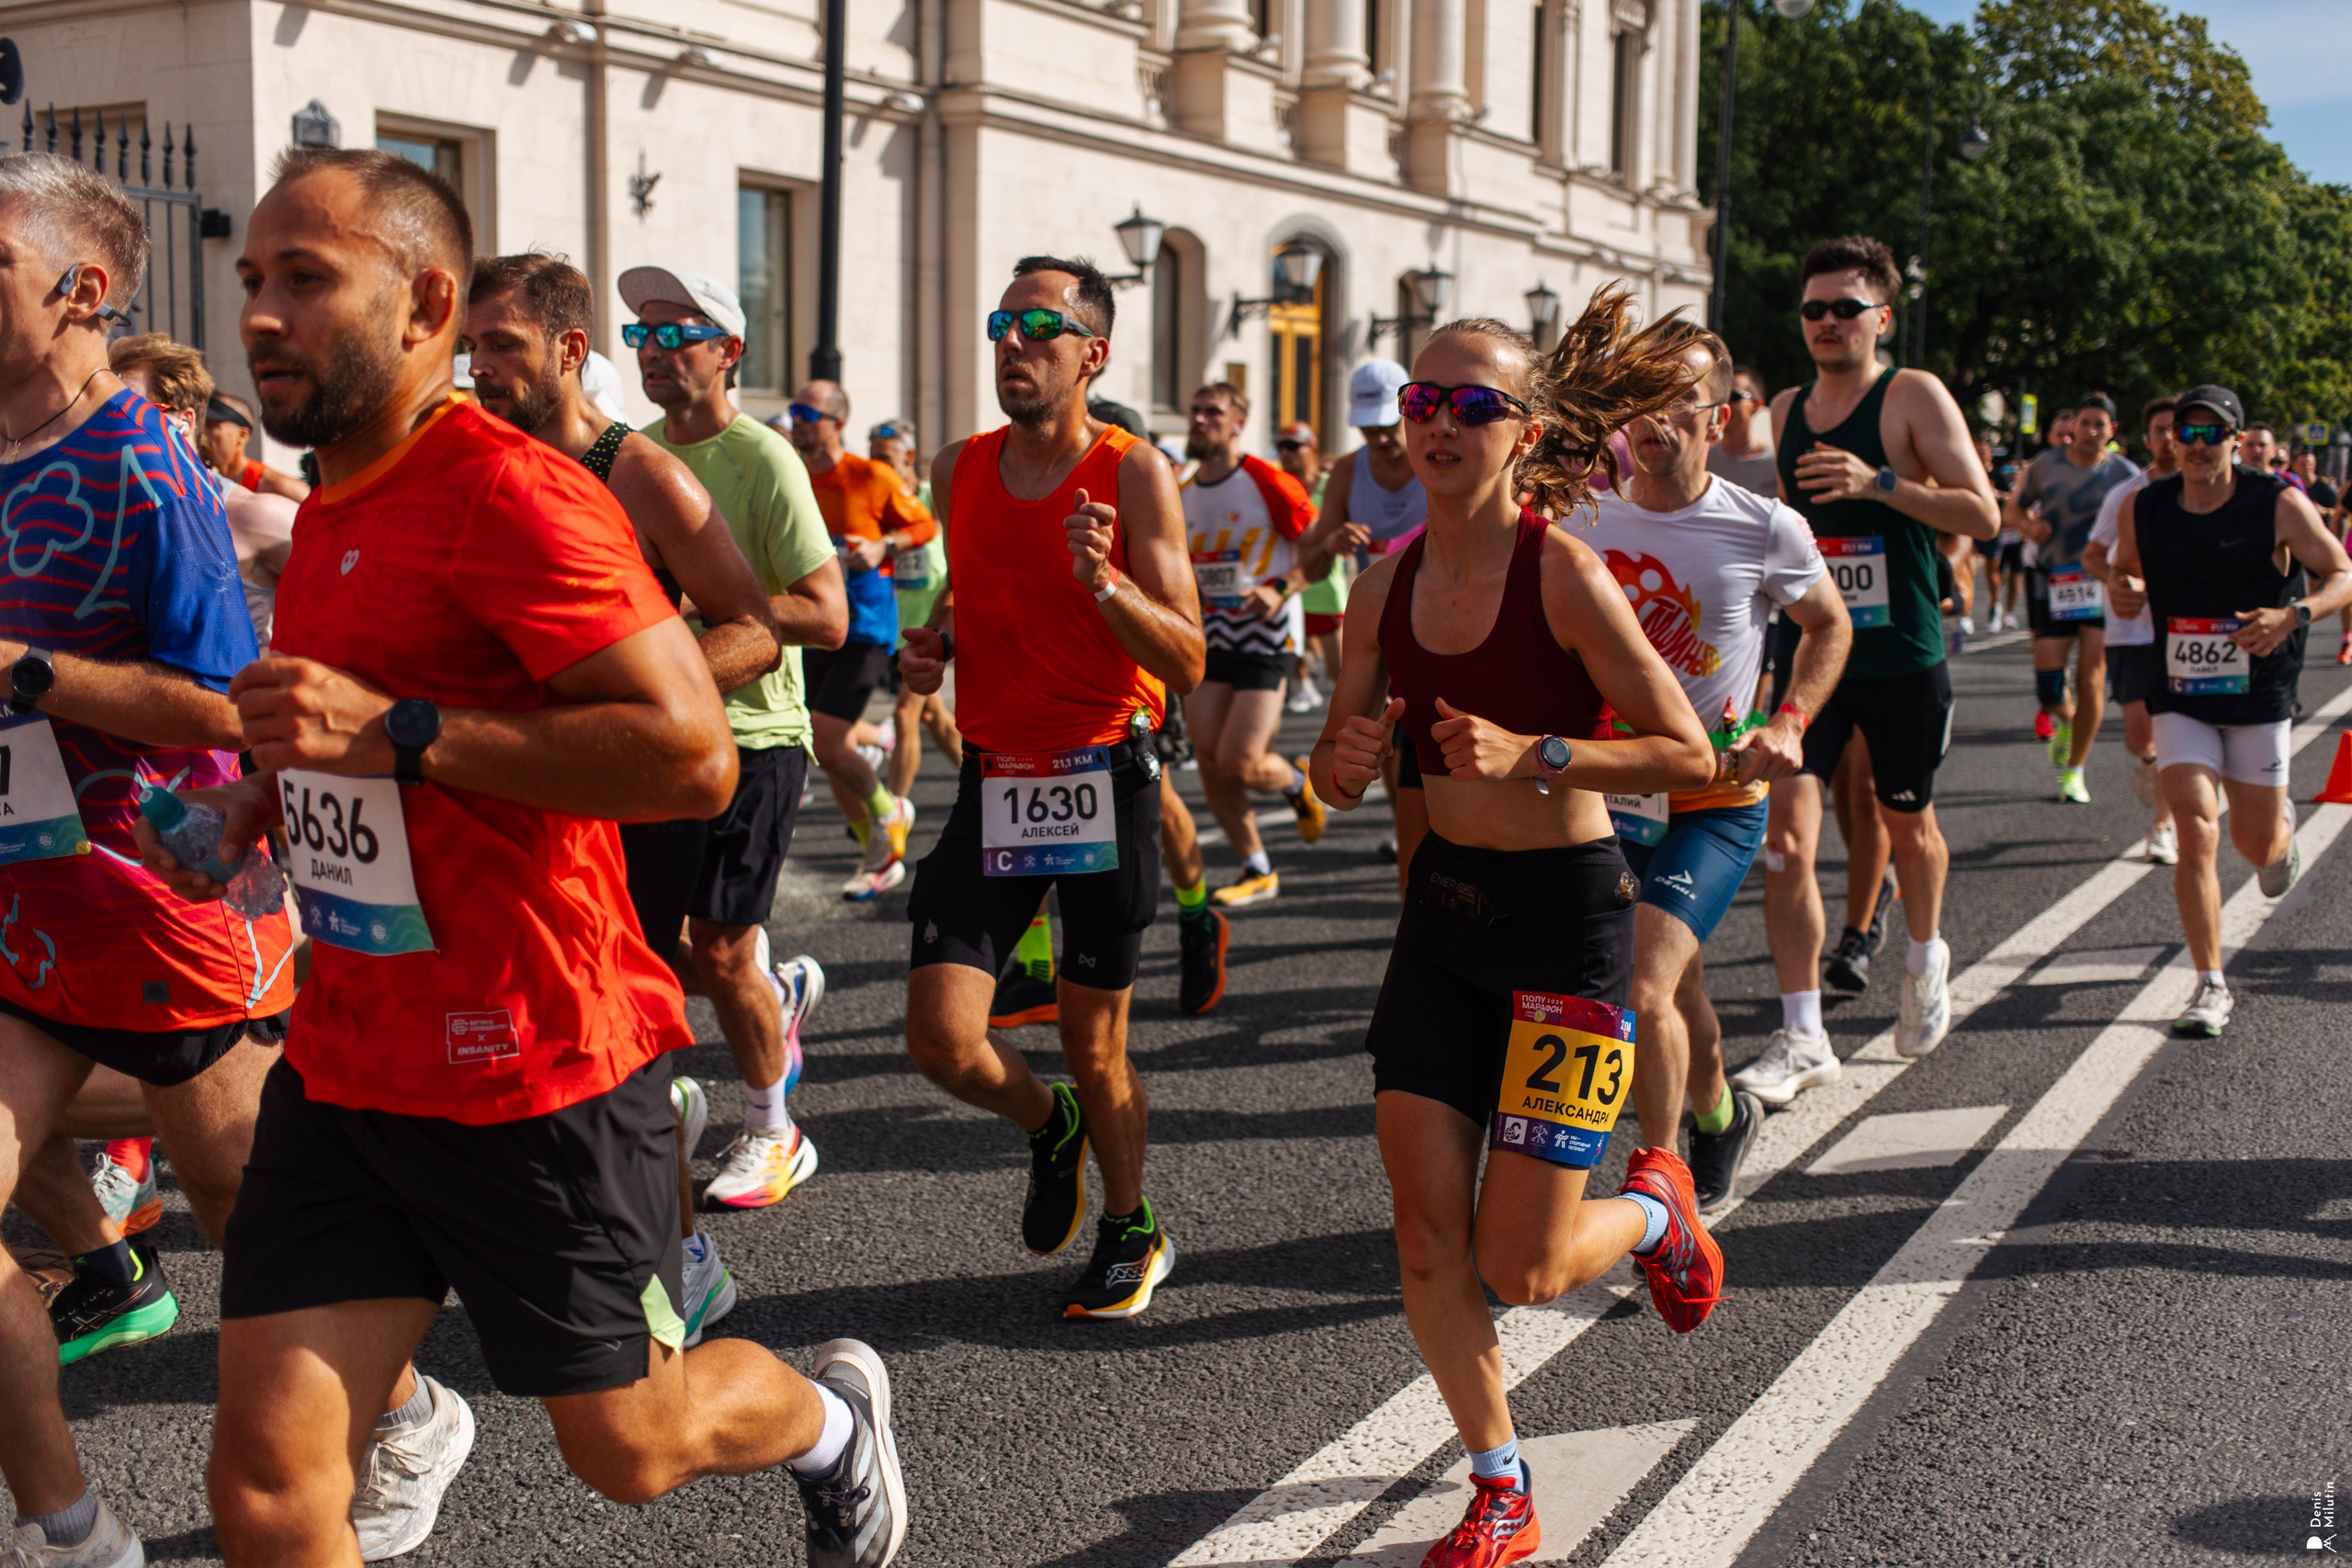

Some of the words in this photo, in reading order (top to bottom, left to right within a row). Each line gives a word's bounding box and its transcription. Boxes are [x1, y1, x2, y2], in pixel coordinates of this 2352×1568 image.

[1826, 564, 1873, 591] 00
[2175, 640, 2237, 664] 4862
[1052, 758, 1072, 769] 21,1
[1074, 754, 1093, 766] КМ
[1003, 783, 1098, 824] 1630
[283, 779, 379, 863] 5636
[1021, 822, 1080, 839] АЛЕКСЕЙ
[311, 858, 353, 886] ДАНИЛ
[997, 851, 1012, 872] C
[1521, 994, 1546, 1004] ПОЛУ
[1521, 1001, 1563, 1014] МАРАФОН
[458, 1043, 509, 1055] INSANITY
[1526, 1033, 1623, 1106] 213
